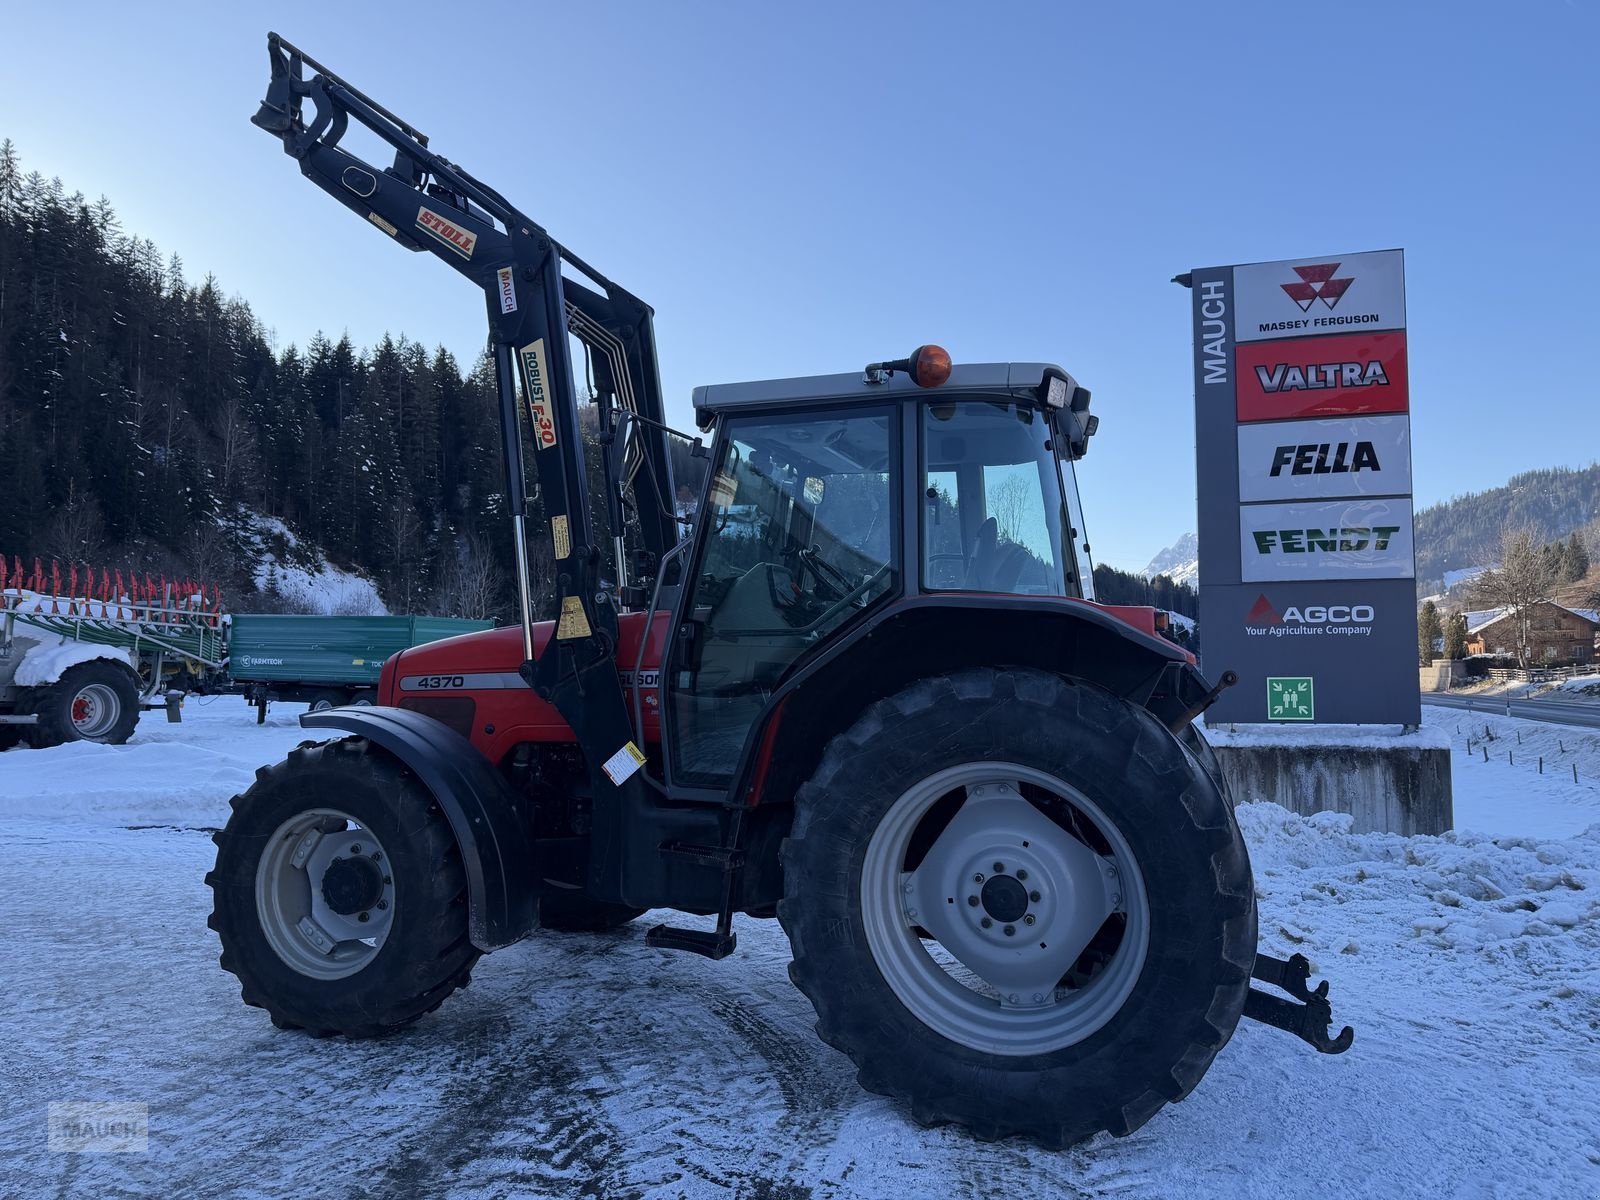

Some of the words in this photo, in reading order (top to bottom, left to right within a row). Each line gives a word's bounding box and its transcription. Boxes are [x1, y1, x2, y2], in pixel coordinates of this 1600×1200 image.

[418, 210, 475, 254] STOLL
[500, 270, 514, 312] MAUCH
[1201, 280, 1227, 384] MAUCH
[1259, 319, 1310, 332] MASSEY
[1314, 314, 1380, 327] FERGUSON
[526, 351, 545, 403] ROBUST
[1255, 360, 1390, 393] VALTRA
[1269, 441, 1381, 477] FELLA
[1252, 526, 1400, 555] FENDT
[1282, 605, 1375, 623] AGCO
[1245, 626, 1267, 636] Your
[1269, 625, 1323, 638] Agriculture
[1326, 625, 1372, 637] Company
[418, 676, 464, 688] 4370
